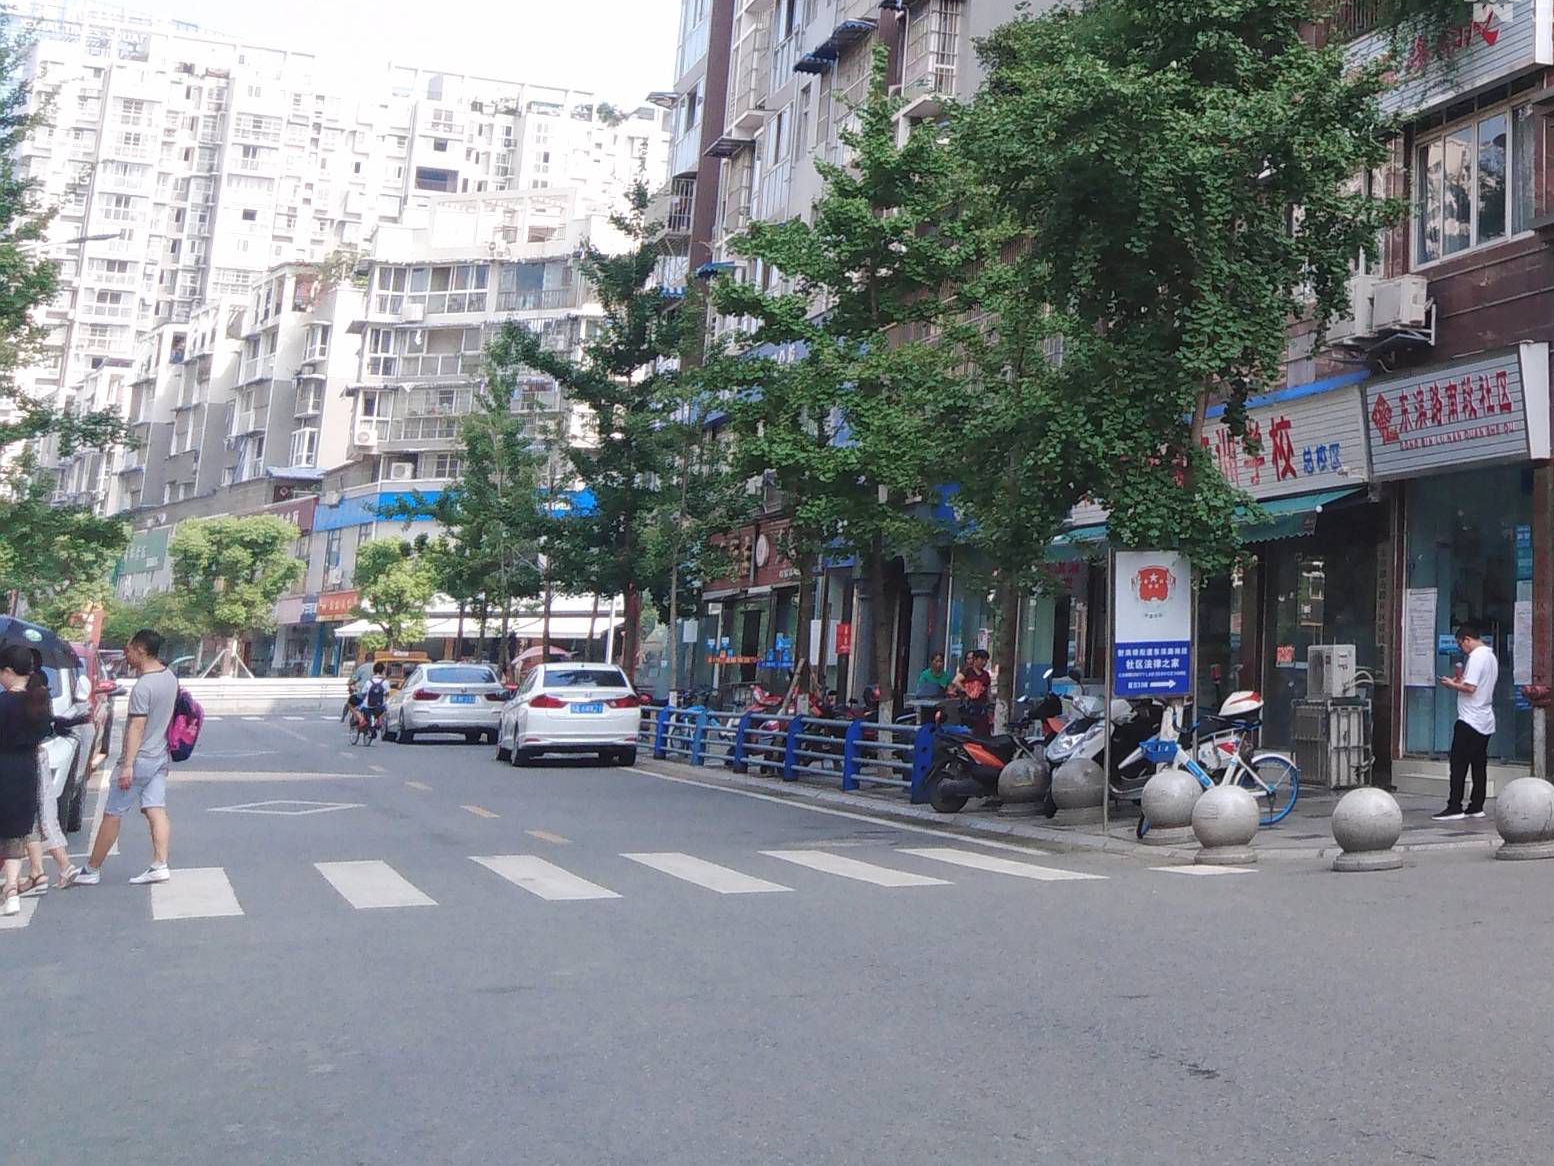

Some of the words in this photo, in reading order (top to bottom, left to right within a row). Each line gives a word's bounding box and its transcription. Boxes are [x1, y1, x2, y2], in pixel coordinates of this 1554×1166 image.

[1125, 658, 1180, 670] 社区法律之家
